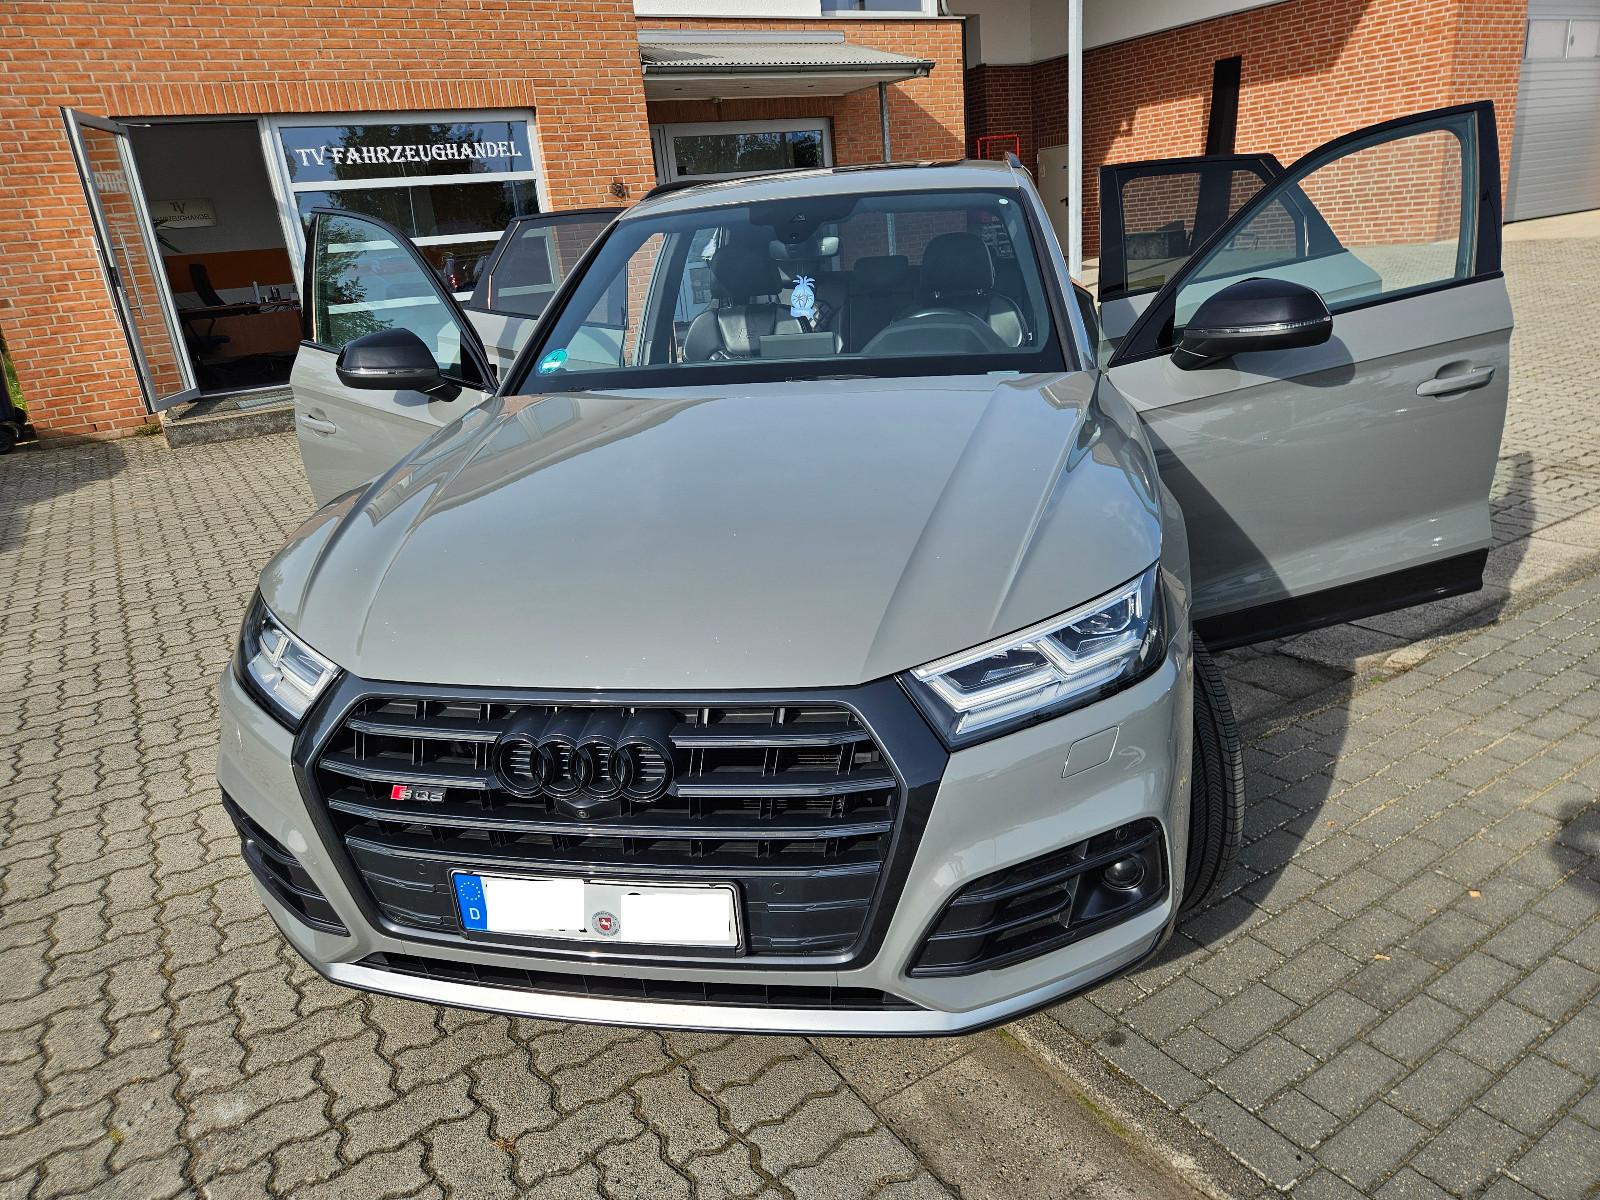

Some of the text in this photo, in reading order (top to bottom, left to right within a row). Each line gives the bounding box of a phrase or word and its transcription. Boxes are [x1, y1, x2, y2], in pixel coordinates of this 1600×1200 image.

[296, 141, 522, 167] TV FAHRZEUGHANDEL
[469, 907, 480, 920] D
